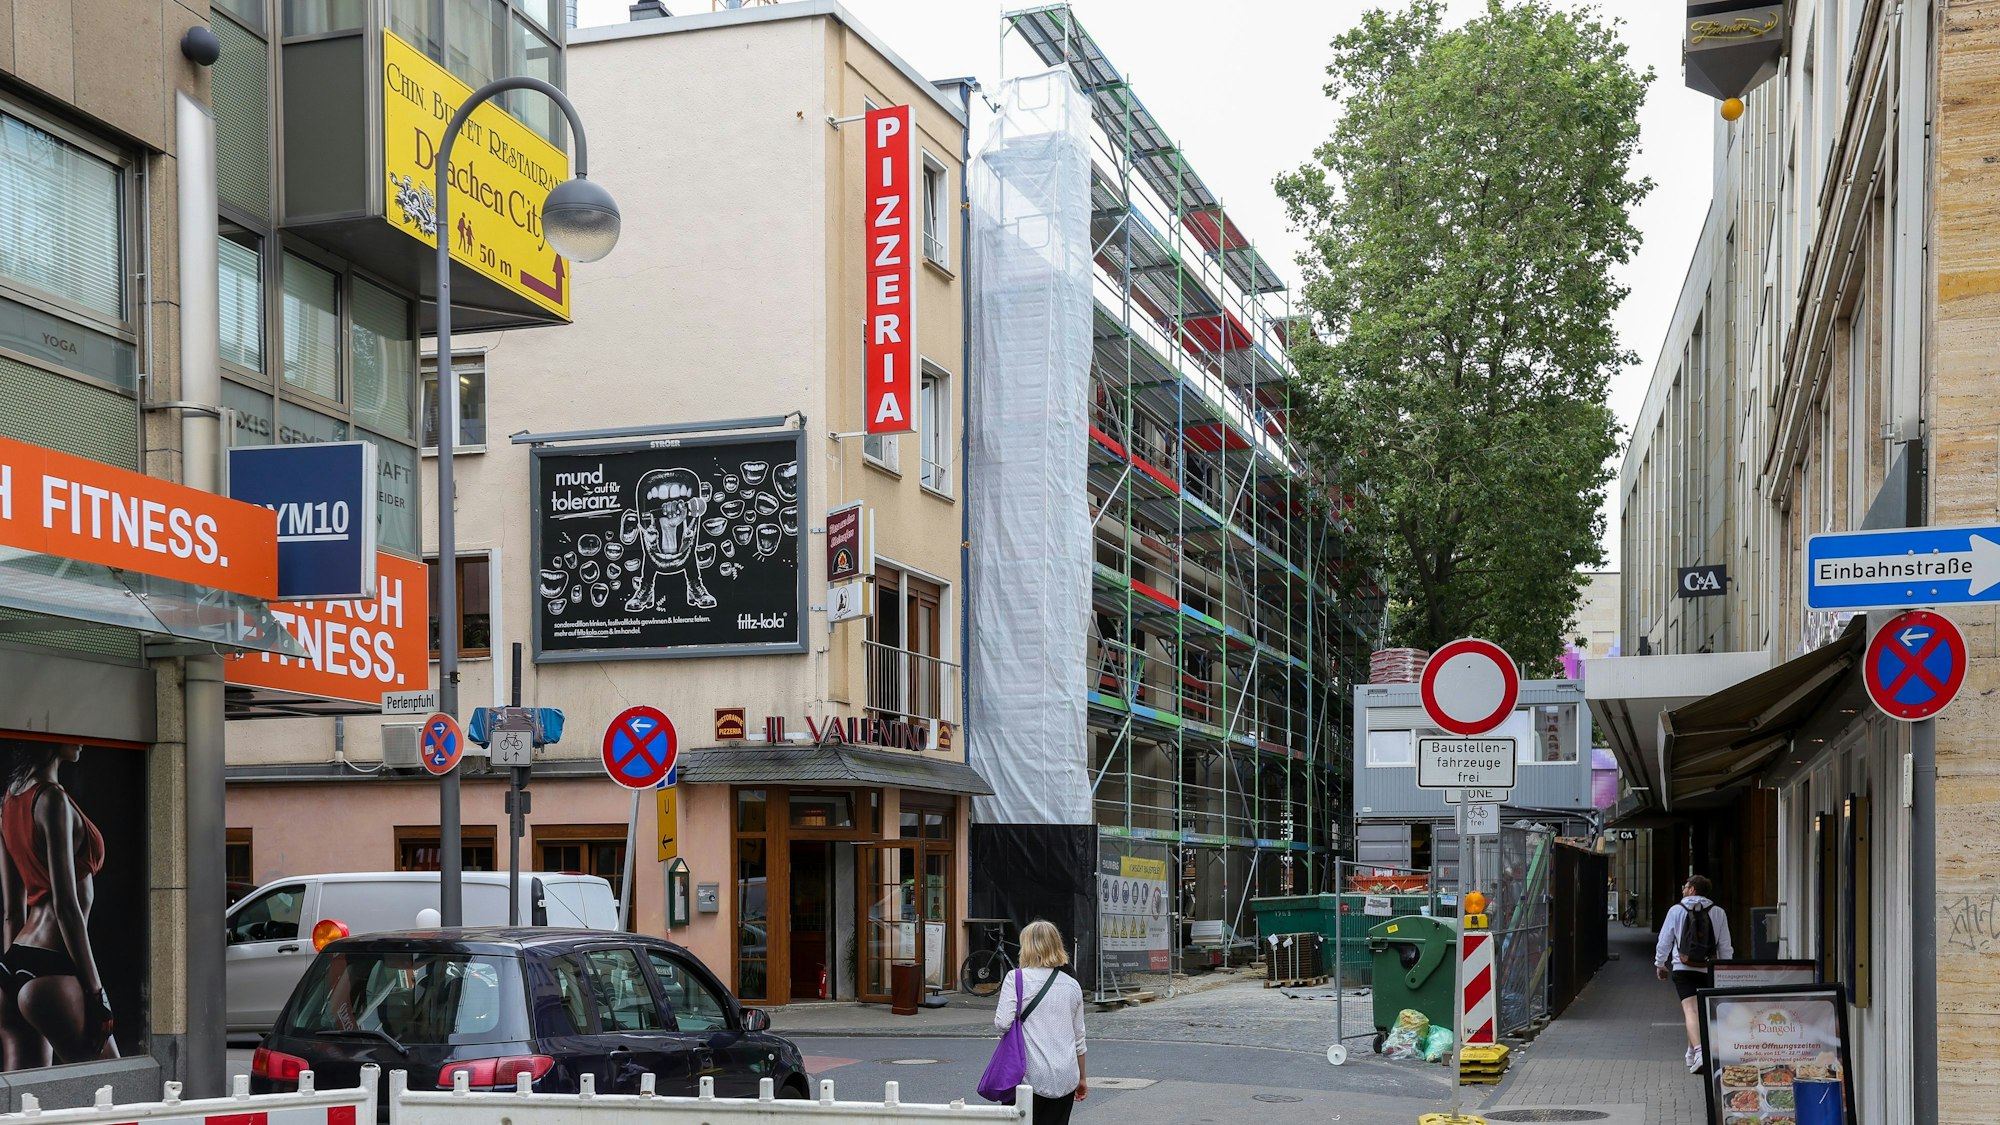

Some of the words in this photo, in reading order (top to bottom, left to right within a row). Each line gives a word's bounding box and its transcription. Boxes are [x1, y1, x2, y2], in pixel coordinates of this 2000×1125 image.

[386, 63, 427, 111] CHIN.
[433, 91, 482, 146] BUET
[414, 127, 505, 218] Dachen
[479, 244, 495, 268] 50
[500, 258, 512, 278] m
[875, 116, 903, 423] PIZZERIA
[42, 332, 78, 355] YOGA
[556, 463, 603, 486] mund
[594, 482, 609, 494] auf
[609, 482, 620, 493] für
[551, 490, 621, 511] toleranz.
[42, 474, 229, 568] FITNESS.
[1820, 558, 1973, 580] Einbahnstraße
[1684, 571, 1721, 591] C&A
[673, 616, 694, 624] toleranz
[737, 612, 785, 630] fritz-kola
[387, 695, 434, 711] Perlenpfuhl
[716, 713, 743, 728] RISTORANTE
[718, 727, 742, 736] PIZZERIA
[765, 716, 793, 744] IL
[804, 715, 928, 751] VALENTINO
[1432, 742, 1507, 753] Baustellen-
[1437, 757, 1501, 771] fahrzeuge
[1458, 772, 1480, 782] frei
[1468, 789, 1493, 798] ONE
[664, 799, 670, 814] U
[1758, 1023, 1796, 1036] Rangoli
[1761, 1042, 1821, 1050] Öffnungszeiten
